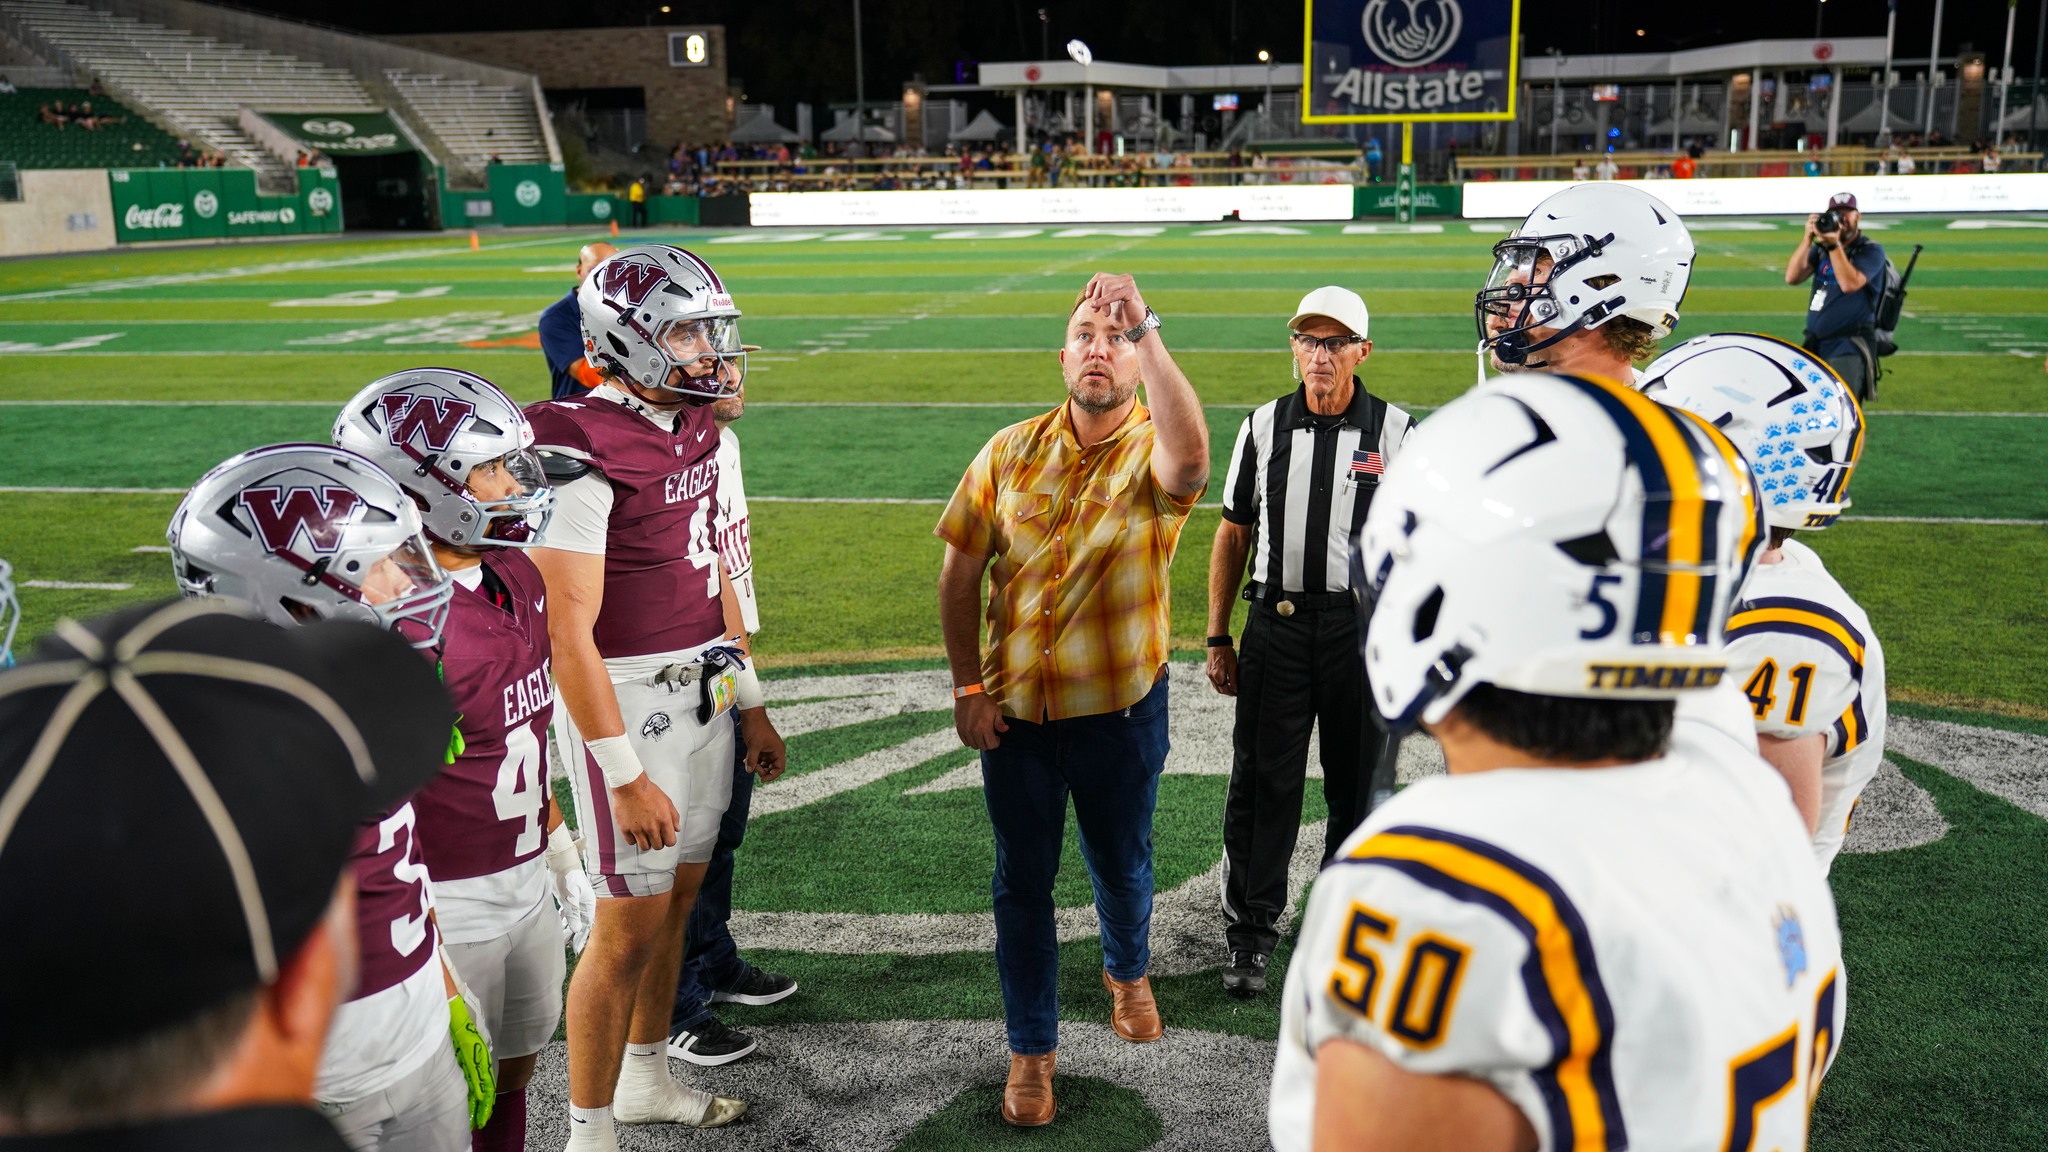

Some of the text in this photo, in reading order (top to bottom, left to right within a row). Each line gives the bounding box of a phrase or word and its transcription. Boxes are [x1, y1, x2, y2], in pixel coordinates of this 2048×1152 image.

[1331, 67, 1484, 109] Allstate
[227, 209, 278, 225] SAFEWAY
[602, 259, 671, 307] W
[378, 392, 477, 452] W
[239, 485, 363, 554] W
[684, 495, 720, 599] 4
[1580, 575, 1622, 640] 5
[1740, 656, 1817, 727] 41
[1326, 900, 1473, 1052] 50
